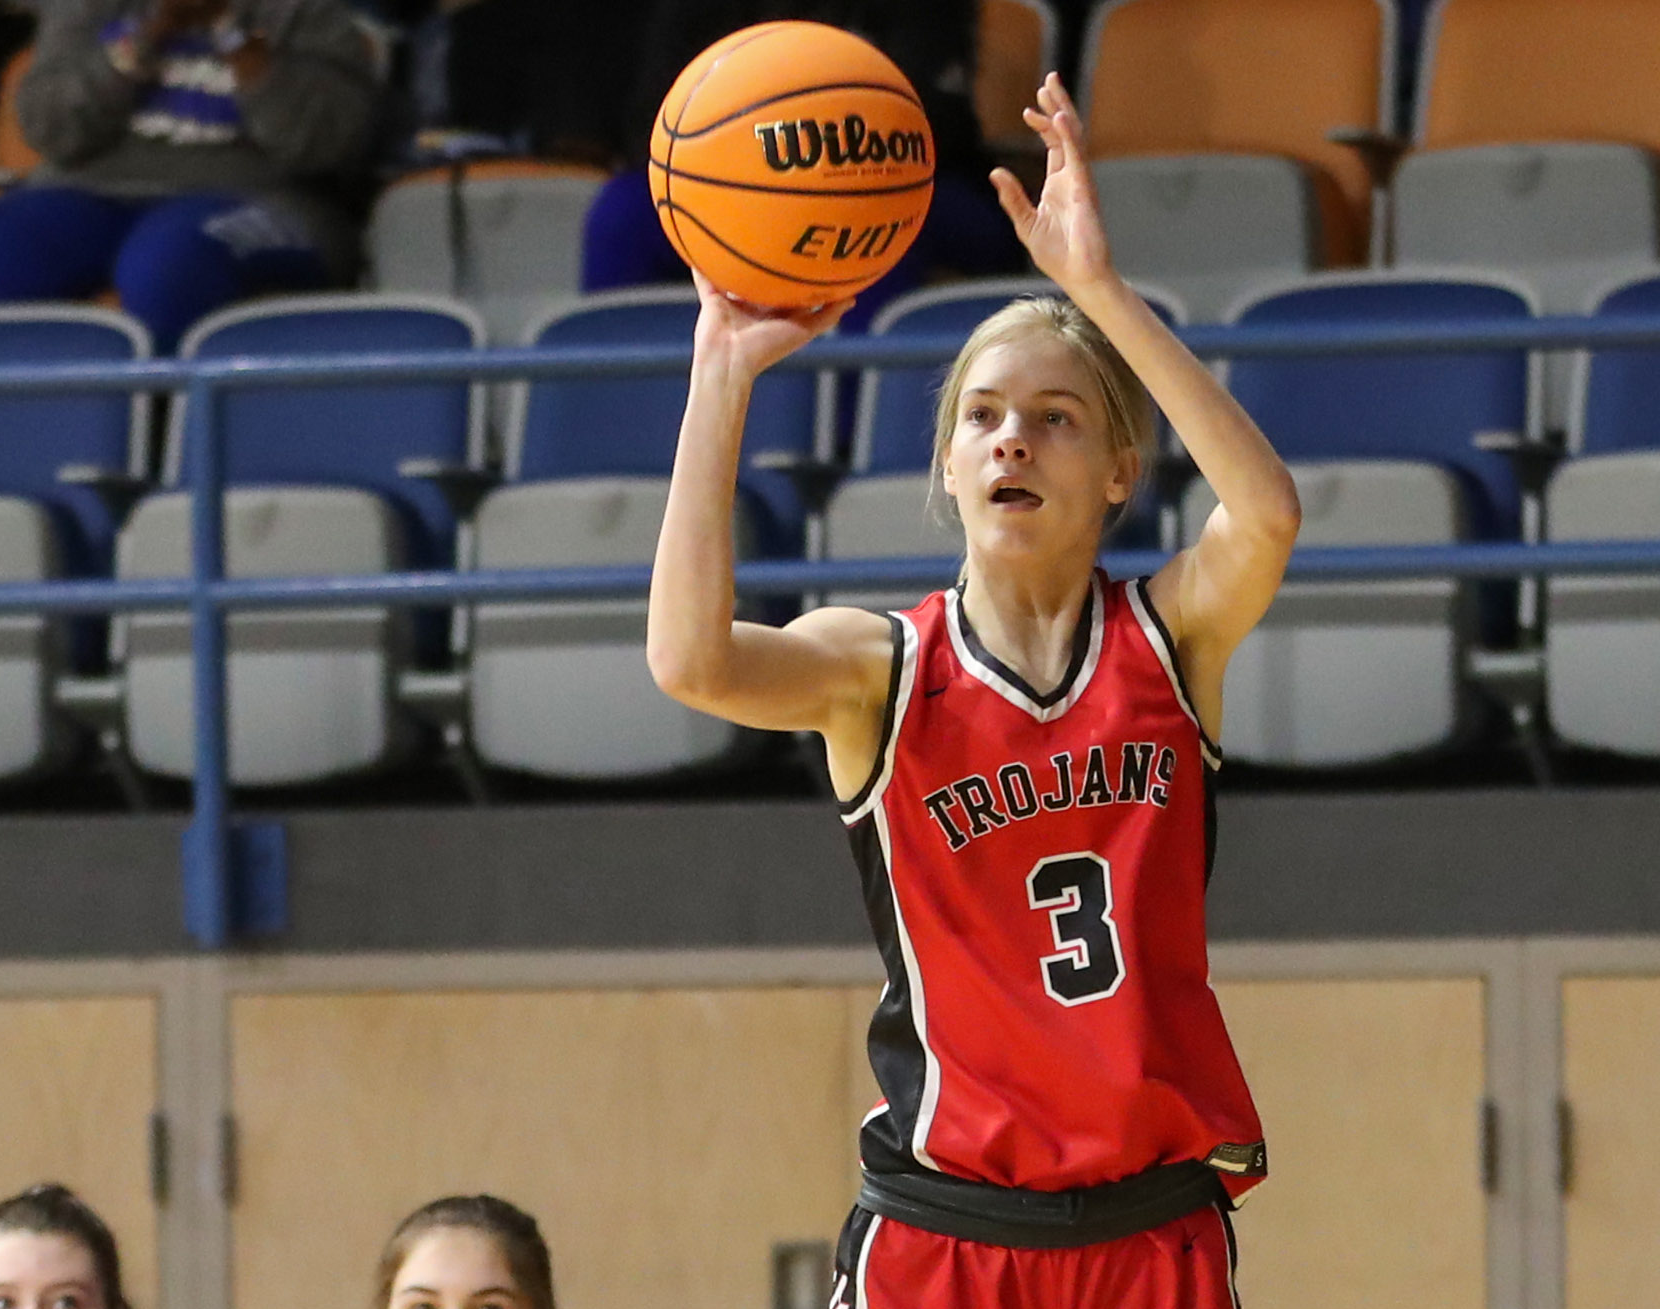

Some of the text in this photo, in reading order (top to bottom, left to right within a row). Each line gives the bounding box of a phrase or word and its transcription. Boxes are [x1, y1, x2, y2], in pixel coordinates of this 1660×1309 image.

[754, 114, 927, 173] Wilson
[922, 742, 1177, 853] TROJANS
[1025, 850, 1127, 1008] 3
